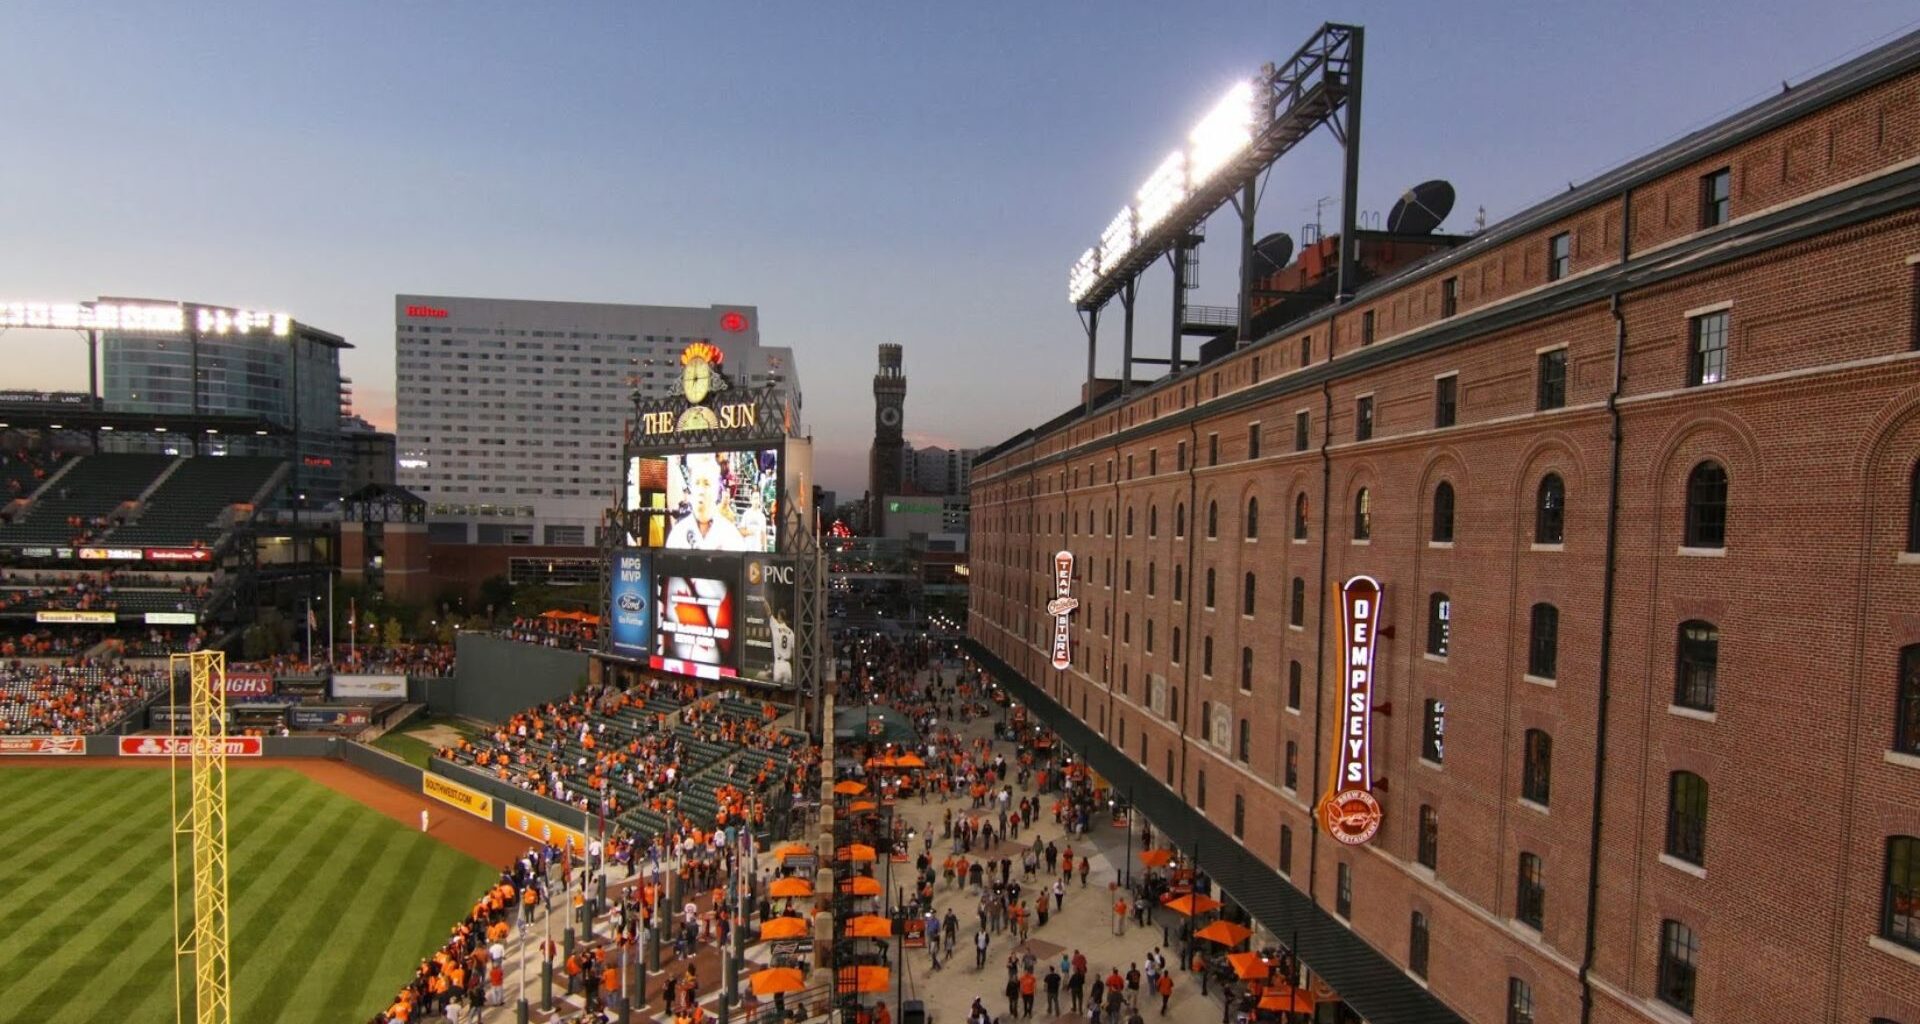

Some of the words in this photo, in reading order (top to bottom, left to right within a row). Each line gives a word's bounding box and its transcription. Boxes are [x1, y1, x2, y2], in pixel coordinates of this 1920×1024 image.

[406, 305, 448, 318] Hilton
[643, 411, 674, 435] THE
[719, 403, 755, 429] SUN
[621, 557, 641, 570] MPG
[621, 571, 641, 583] MVP
[763, 565, 794, 585] PNC
[1059, 561, 1069, 595] TEAM
[621, 594, 641, 610] Ford
[782, 635, 788, 649] 8
[1057, 616, 1067, 659] STORE
[1347, 599, 1369, 782] DEMPSEYS
[425, 778, 472, 805] SOUTHWEST.COM
